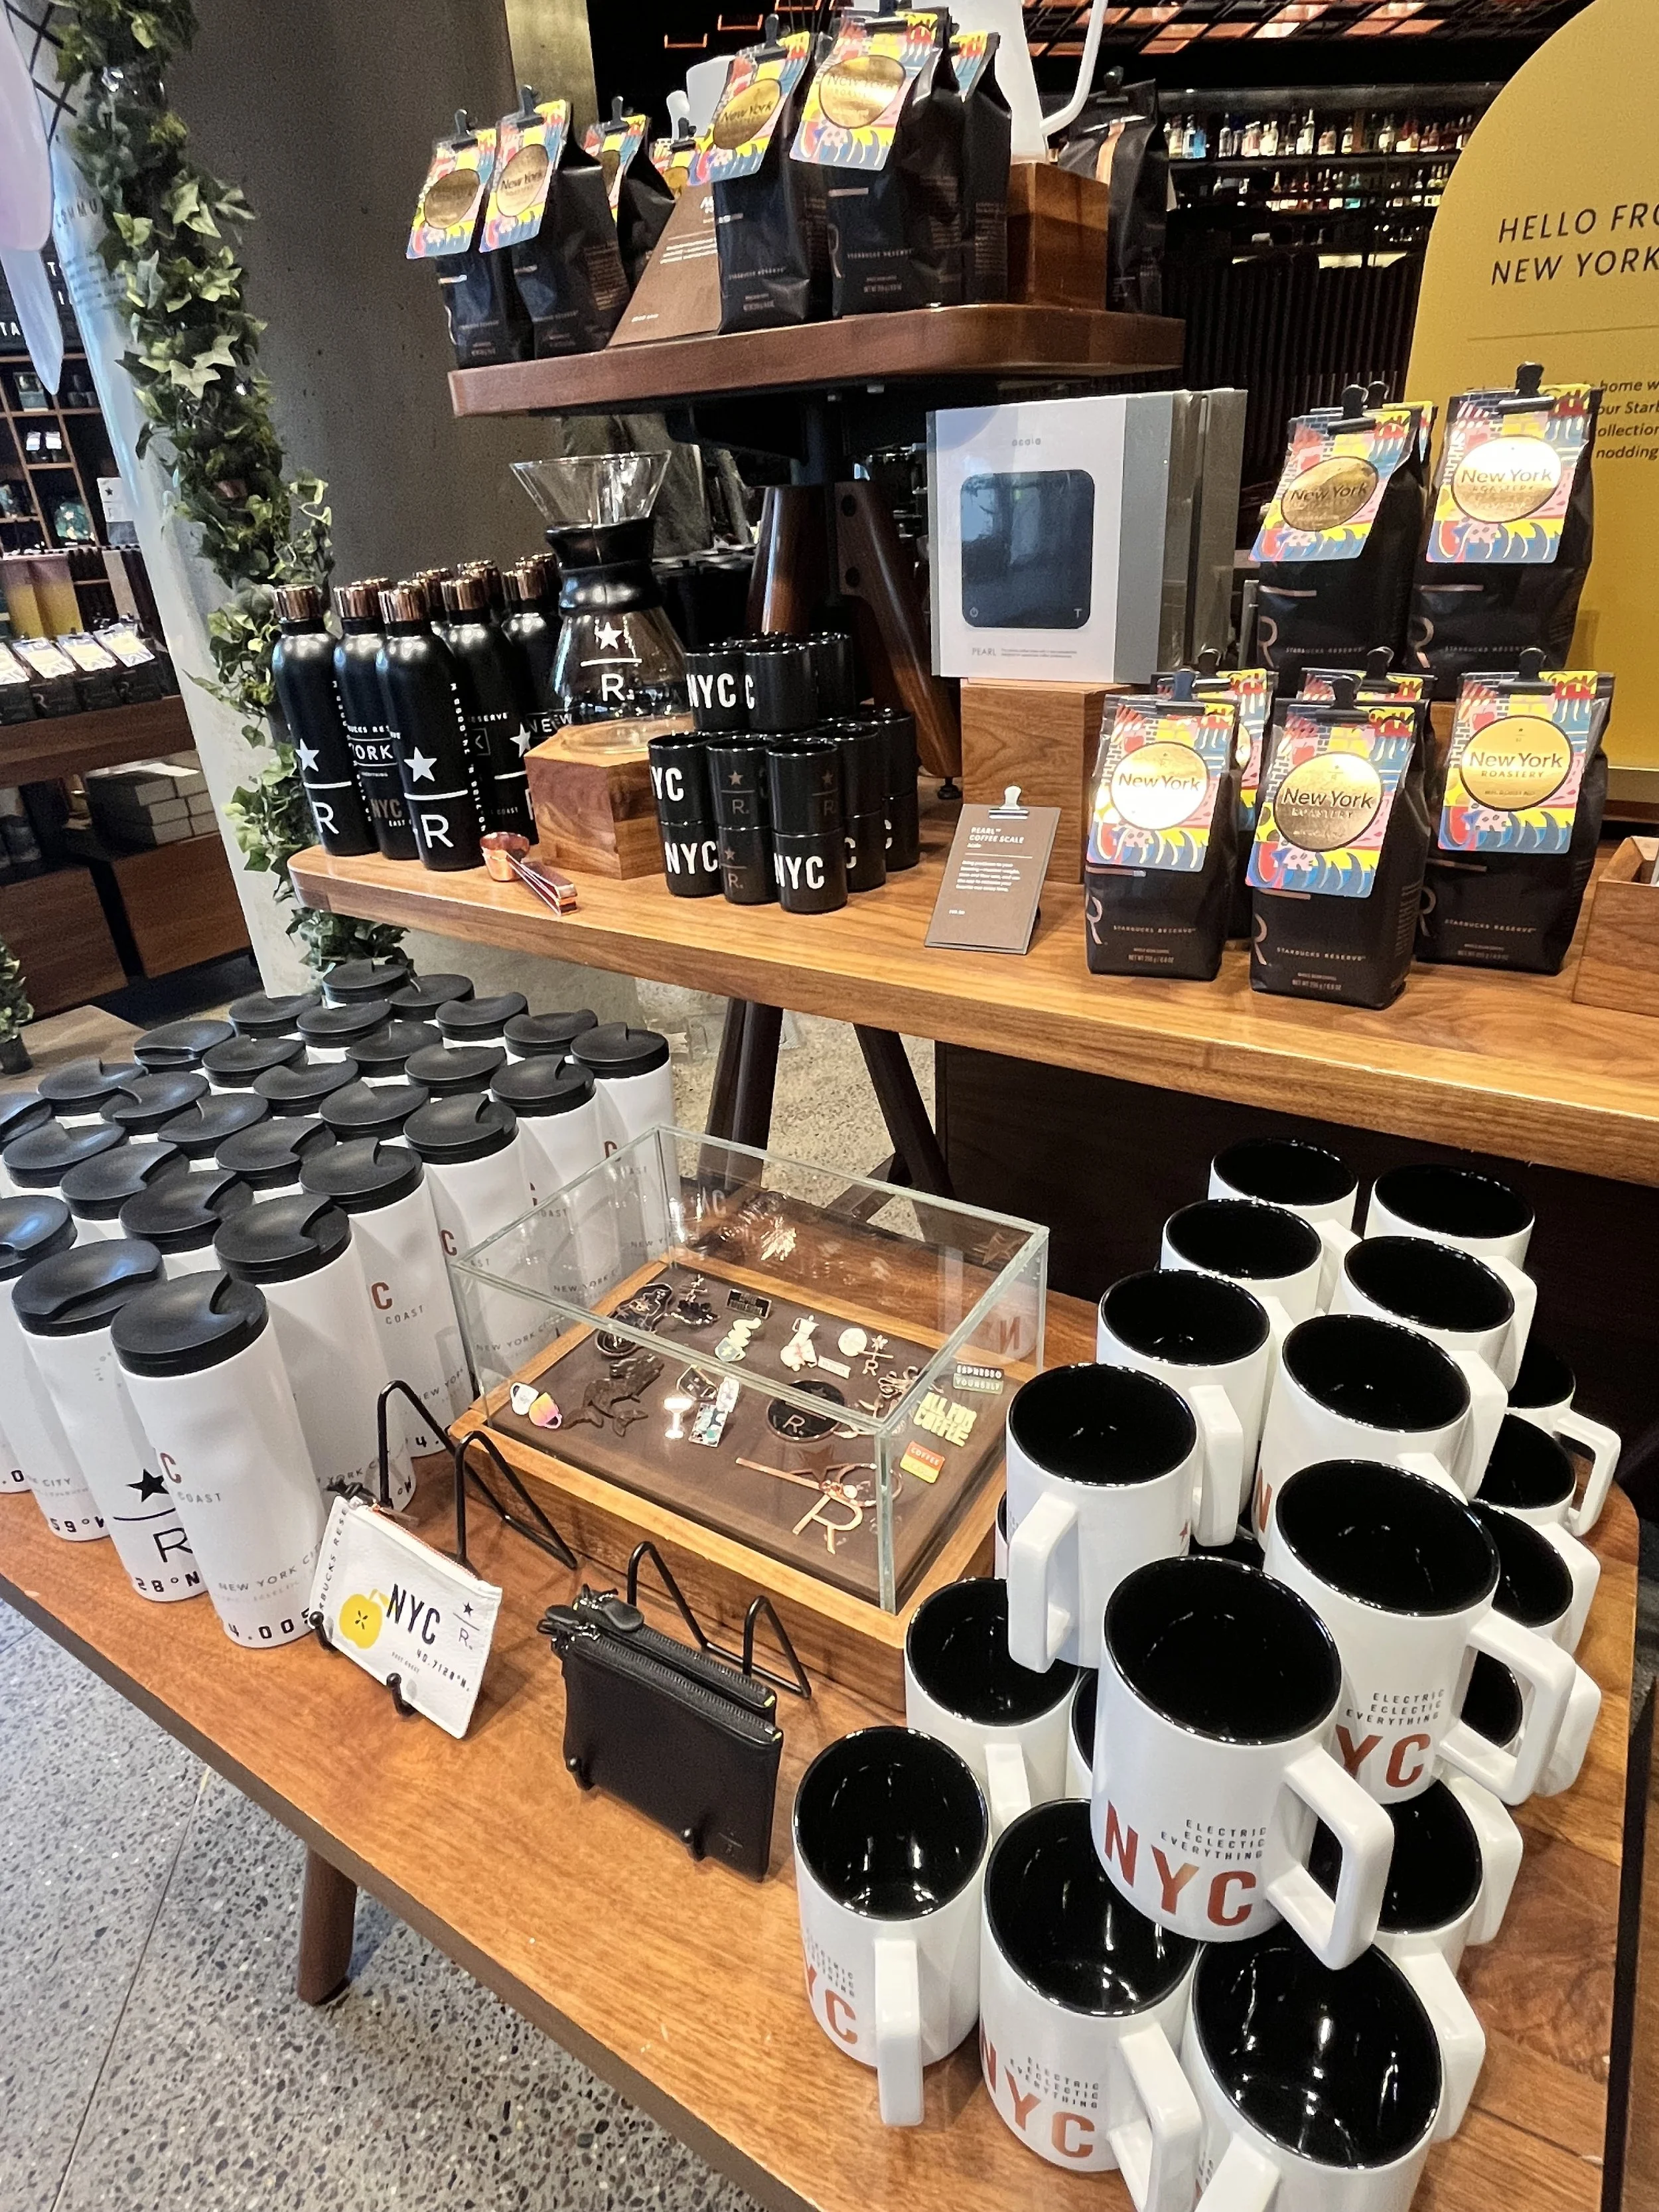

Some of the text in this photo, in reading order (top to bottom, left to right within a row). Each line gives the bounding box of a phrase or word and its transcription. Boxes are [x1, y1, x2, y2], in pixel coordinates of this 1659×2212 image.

[1498, 208, 1597, 244] HELLO
[1491, 245, 1659, 286] NEW YORK
[1600, 380, 1643, 393] home
[1461, 469, 1553, 484] New York
[1290, 482, 1368, 502] New York
[972, 647, 997, 657] PEARL
[686, 672, 737, 709] NYC
[1469, 751, 1564, 769] New York
[1118, 773, 1202, 792] New York
[1480, 770, 1545, 778] ROASTERY
[1282, 787, 1374, 809] New York
[370, 798, 403, 819] NYC
[420, 814, 455, 849] R
[999, 836, 1025, 844] SCALE
[664, 840, 719, 875] NYC
[773, 852, 825, 890] NYC
[1444, 918, 1490, 930] STARBUCKS
[1276, 946, 1363, 962] STARBUCKS RESERVE
[371, 1282, 393, 1310] C
[553, 1284, 578, 1293] NEW
[385, 1304, 424, 1325] COAST
[506, 1333, 535, 1348] YORK
[956, 1363, 1003, 1380] ESPRESSO
[418, 1387, 441, 1402] EW
[920, 1391, 948, 1418] ALL
[913, 1406, 970, 1447] COFFEE
[910, 1446, 941, 1467] COFFEE
[42, 1477, 71, 1487] CITY
[177, 1491, 222, 1503] COAST
[218, 1582, 250, 1591] NEW
[257, 1566, 297, 1585] YORK
[386, 1583, 441, 1645] NYC
[1373, 1688, 1445, 1704] ELECTRIC
[1345, 1708, 1439, 1726] EVERYTHING
[1370, 1700, 1442, 1716] ECLECTIC
[1185, 1818, 1267, 1838] ELECTRIC
[1161, 1831, 1263, 1861] EVERYTHING
[1184, 1831, 1266, 1849] ECLECTIC
[1104, 1799, 1257, 1927] NYC
[1027, 2055, 1100, 2091] ELECTRIC
[1027, 2066, 1099, 2100] ECLECTIC
[979, 2018, 1096, 2159] NYC
[1009, 2058, 1098, 2109] EVERYTHING
